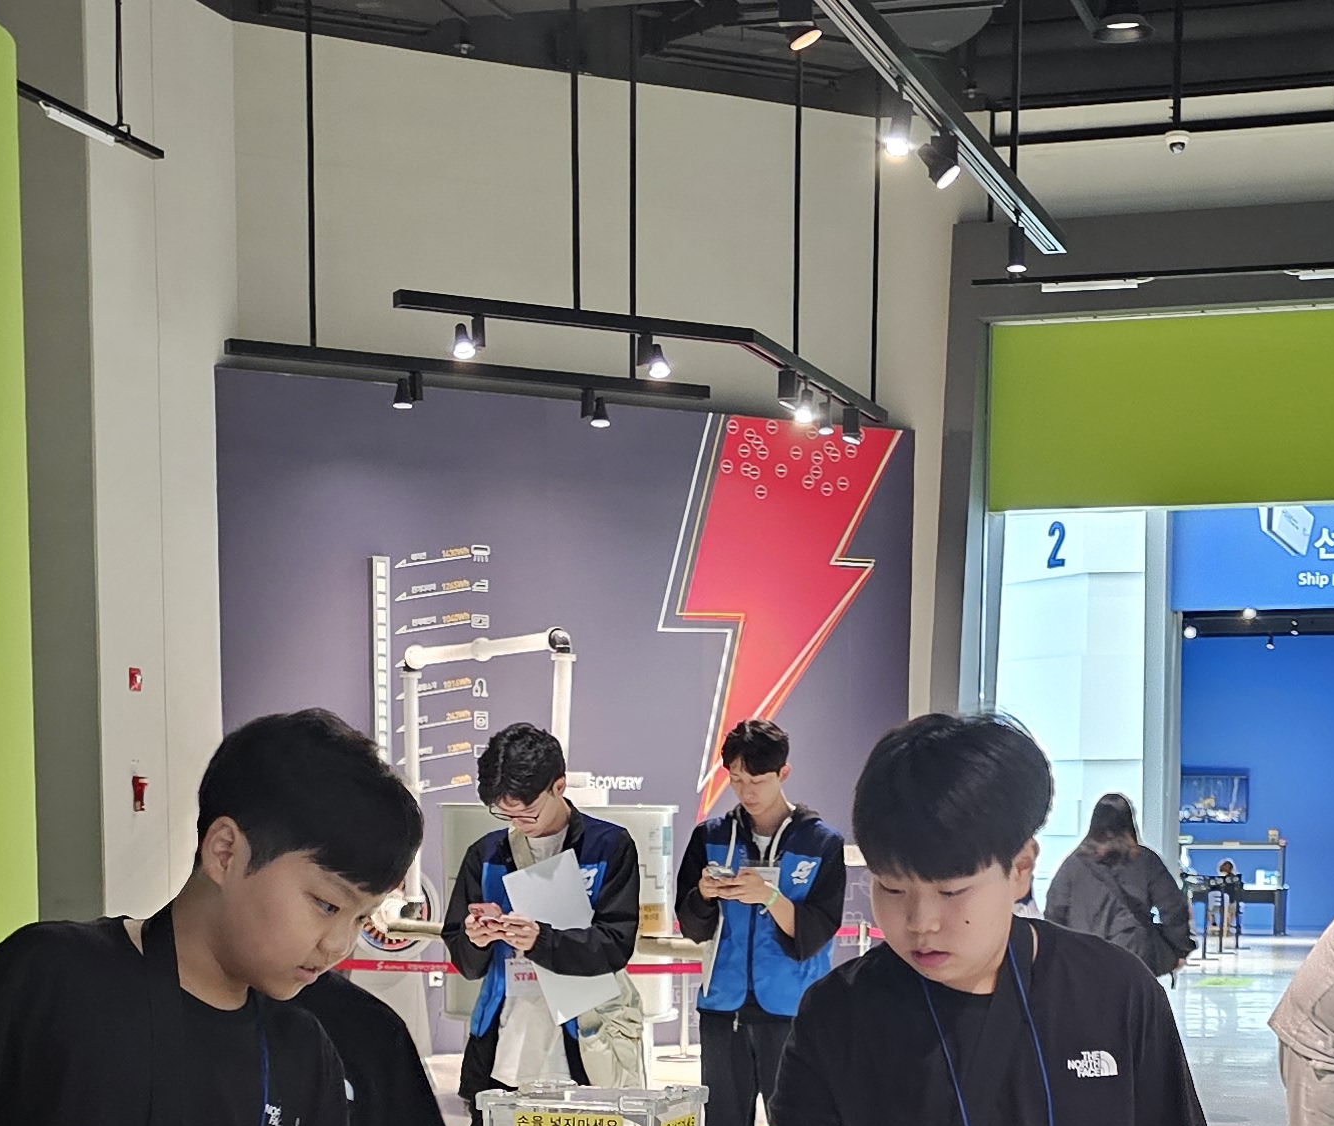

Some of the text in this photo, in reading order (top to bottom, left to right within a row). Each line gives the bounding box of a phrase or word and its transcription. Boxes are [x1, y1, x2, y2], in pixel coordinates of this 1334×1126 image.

[1047, 520, 1066, 569] 2
[1297, 572, 1330, 588] Ship
[588, 776, 644, 791] SCOVERY
[1081, 1050, 1101, 1060] THE
[1067, 1059, 1100, 1070] NORTH
[1077, 1068, 1101, 1078] FACE
